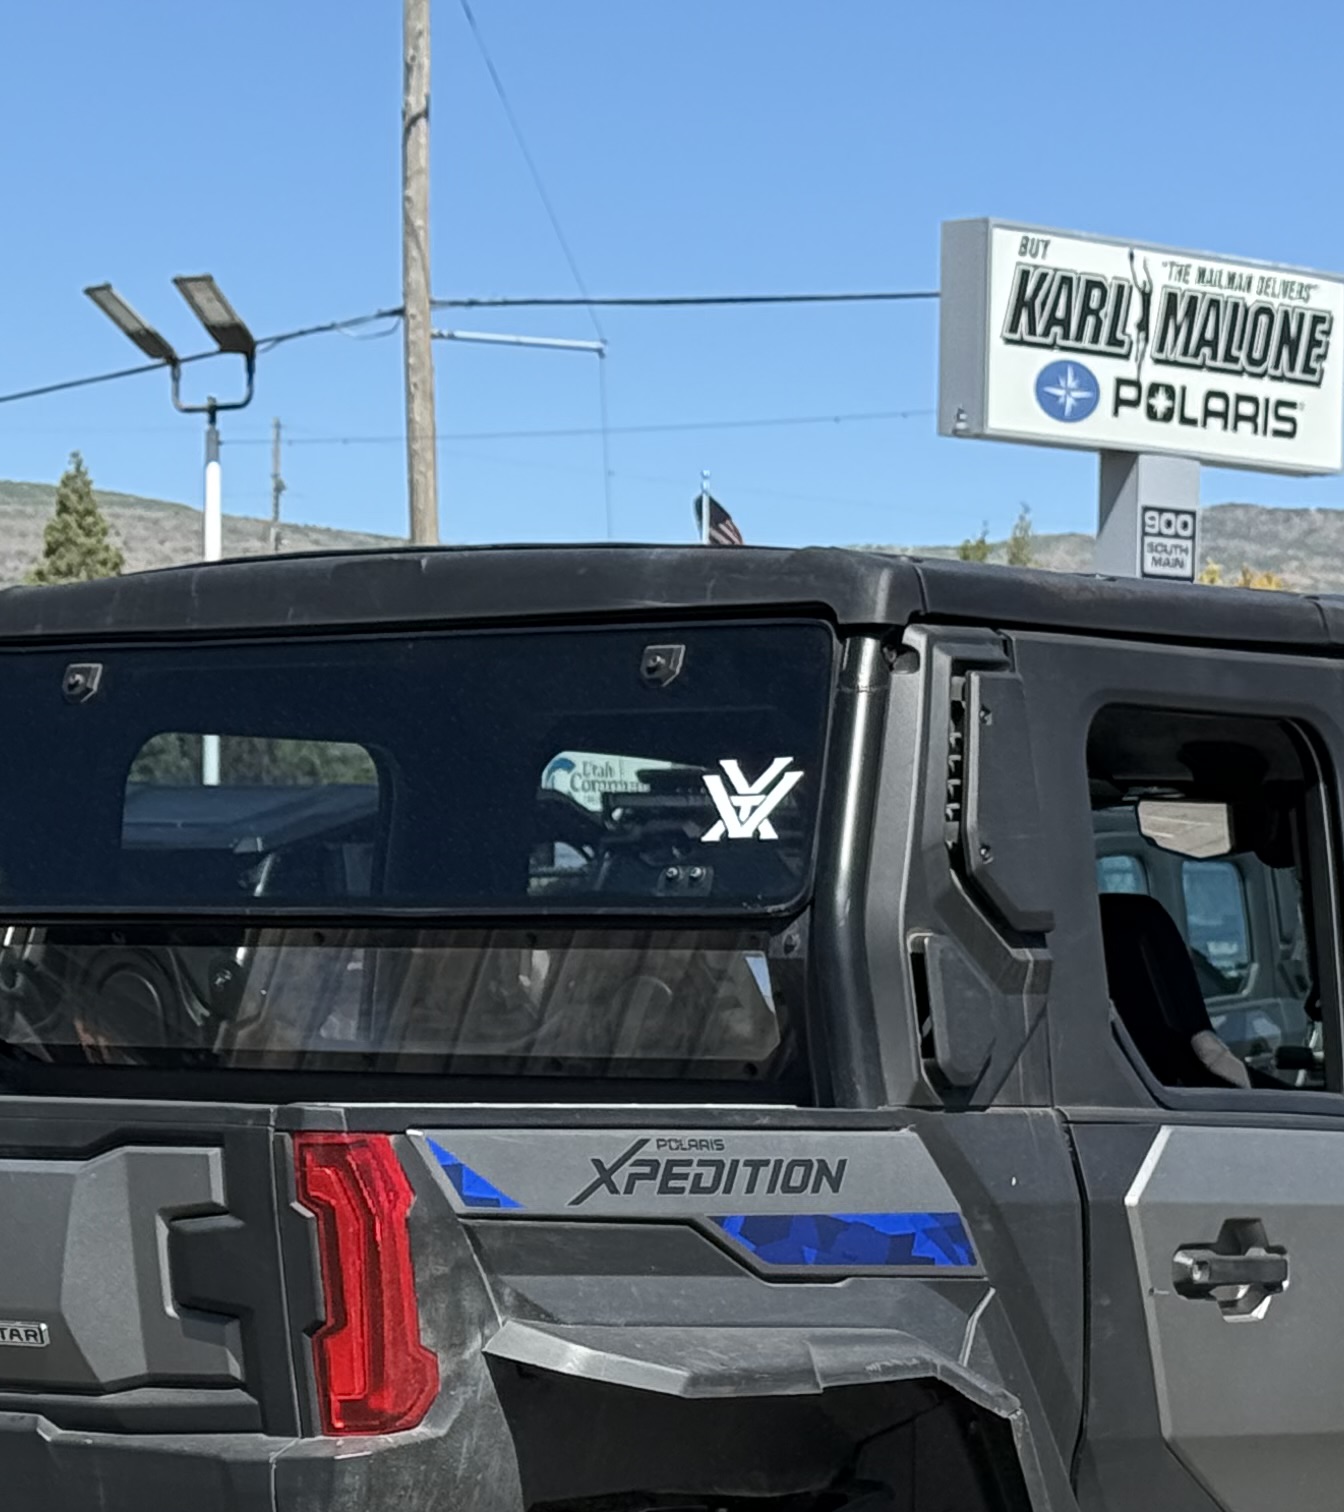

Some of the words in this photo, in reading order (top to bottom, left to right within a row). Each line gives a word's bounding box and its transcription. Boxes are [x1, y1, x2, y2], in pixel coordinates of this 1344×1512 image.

[1018, 236, 1051, 260] BUY
[1001, 262, 1133, 358] KARL
[1151, 286, 1333, 386] MALONE
[1112, 377, 1299, 438] POLARIS
[1144, 510, 1194, 537] 900
[1146, 541, 1189, 556] SOUTH
[1151, 556, 1185, 569] MAIN
[582, 761, 615, 778] Utah
[656, 1138, 725, 1151] POLARIS
[567, 1138, 847, 1206] XPEDITION
